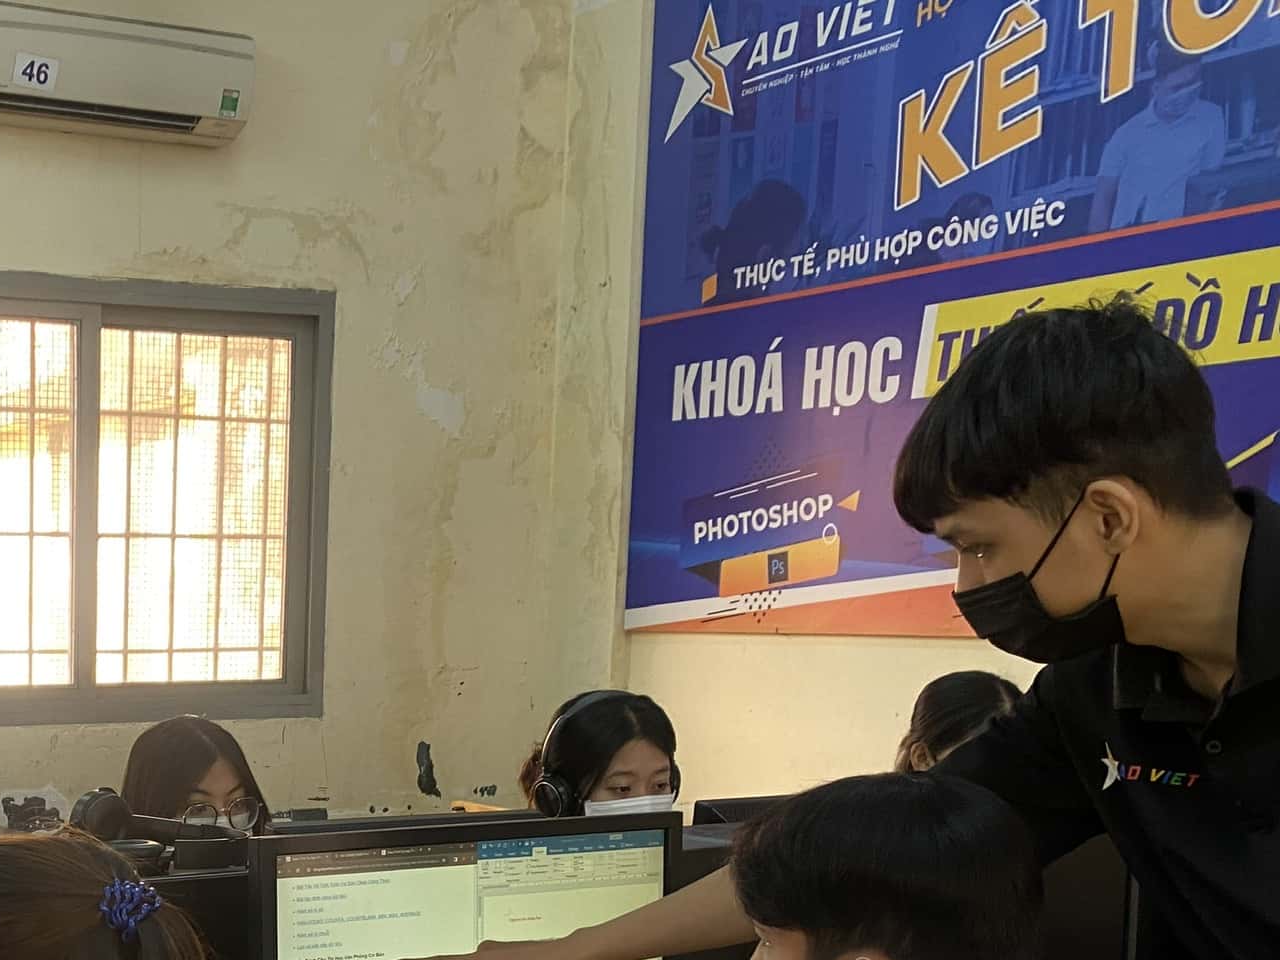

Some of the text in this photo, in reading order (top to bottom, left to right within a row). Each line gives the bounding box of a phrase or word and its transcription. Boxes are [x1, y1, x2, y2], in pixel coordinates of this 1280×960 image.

[20, 60, 50, 85] 46
[734, 197, 1066, 290] THỰC TẾ, PHÙ HỢP CÔNG VIỆC
[671, 336, 784, 422] KHOÁ
[801, 336, 903, 416] HỌC
[693, 494, 833, 545] PHOTOSHOP
[771, 559, 785, 576] Ps
[1150, 768, 1200, 787] VIET
